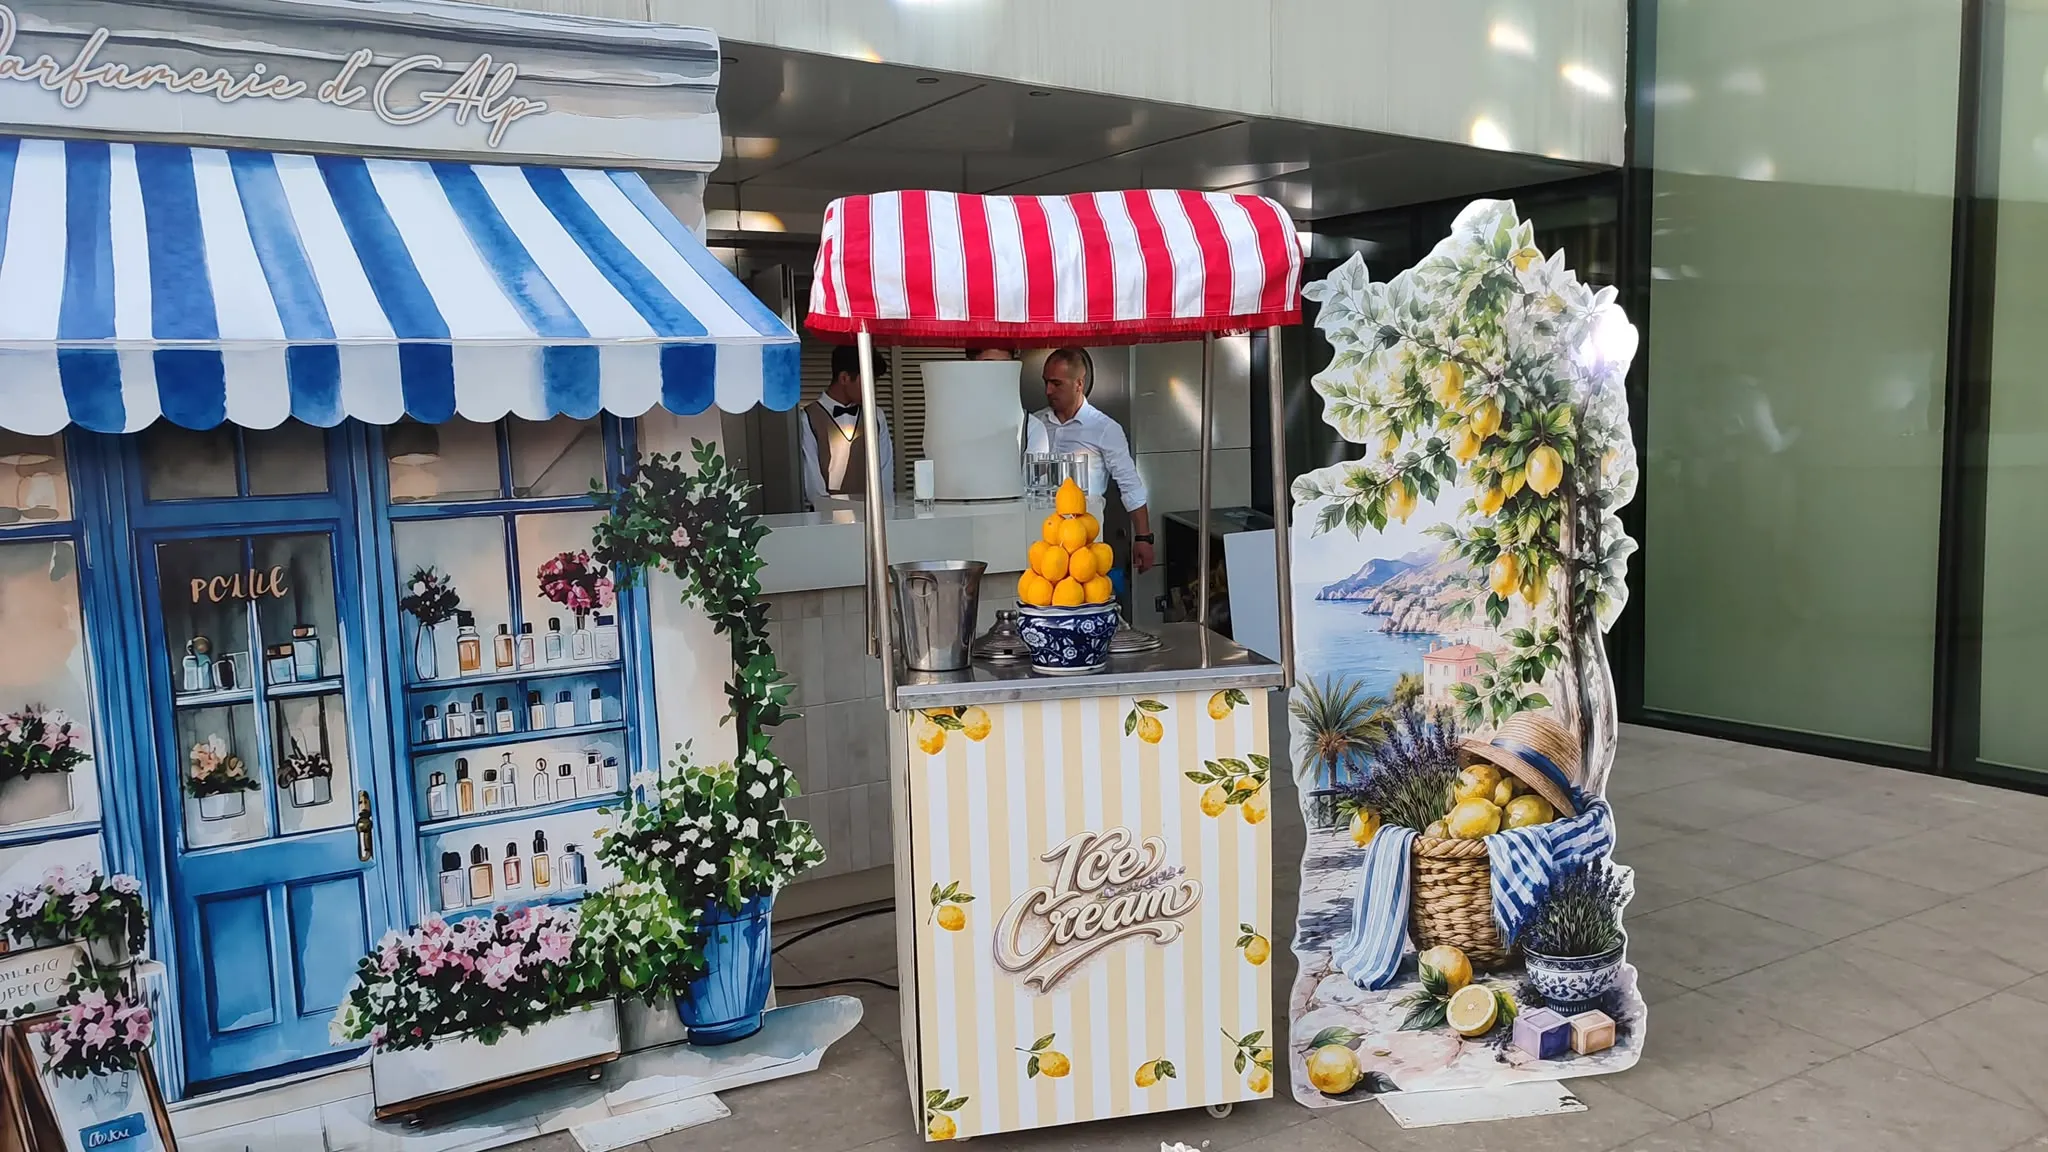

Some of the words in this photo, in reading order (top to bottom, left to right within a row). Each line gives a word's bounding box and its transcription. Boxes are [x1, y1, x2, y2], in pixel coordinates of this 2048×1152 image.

[0, 4, 306, 108] arfumerie
[1040, 826, 1167, 898] Ice
[993, 879, 1203, 972] Cream
